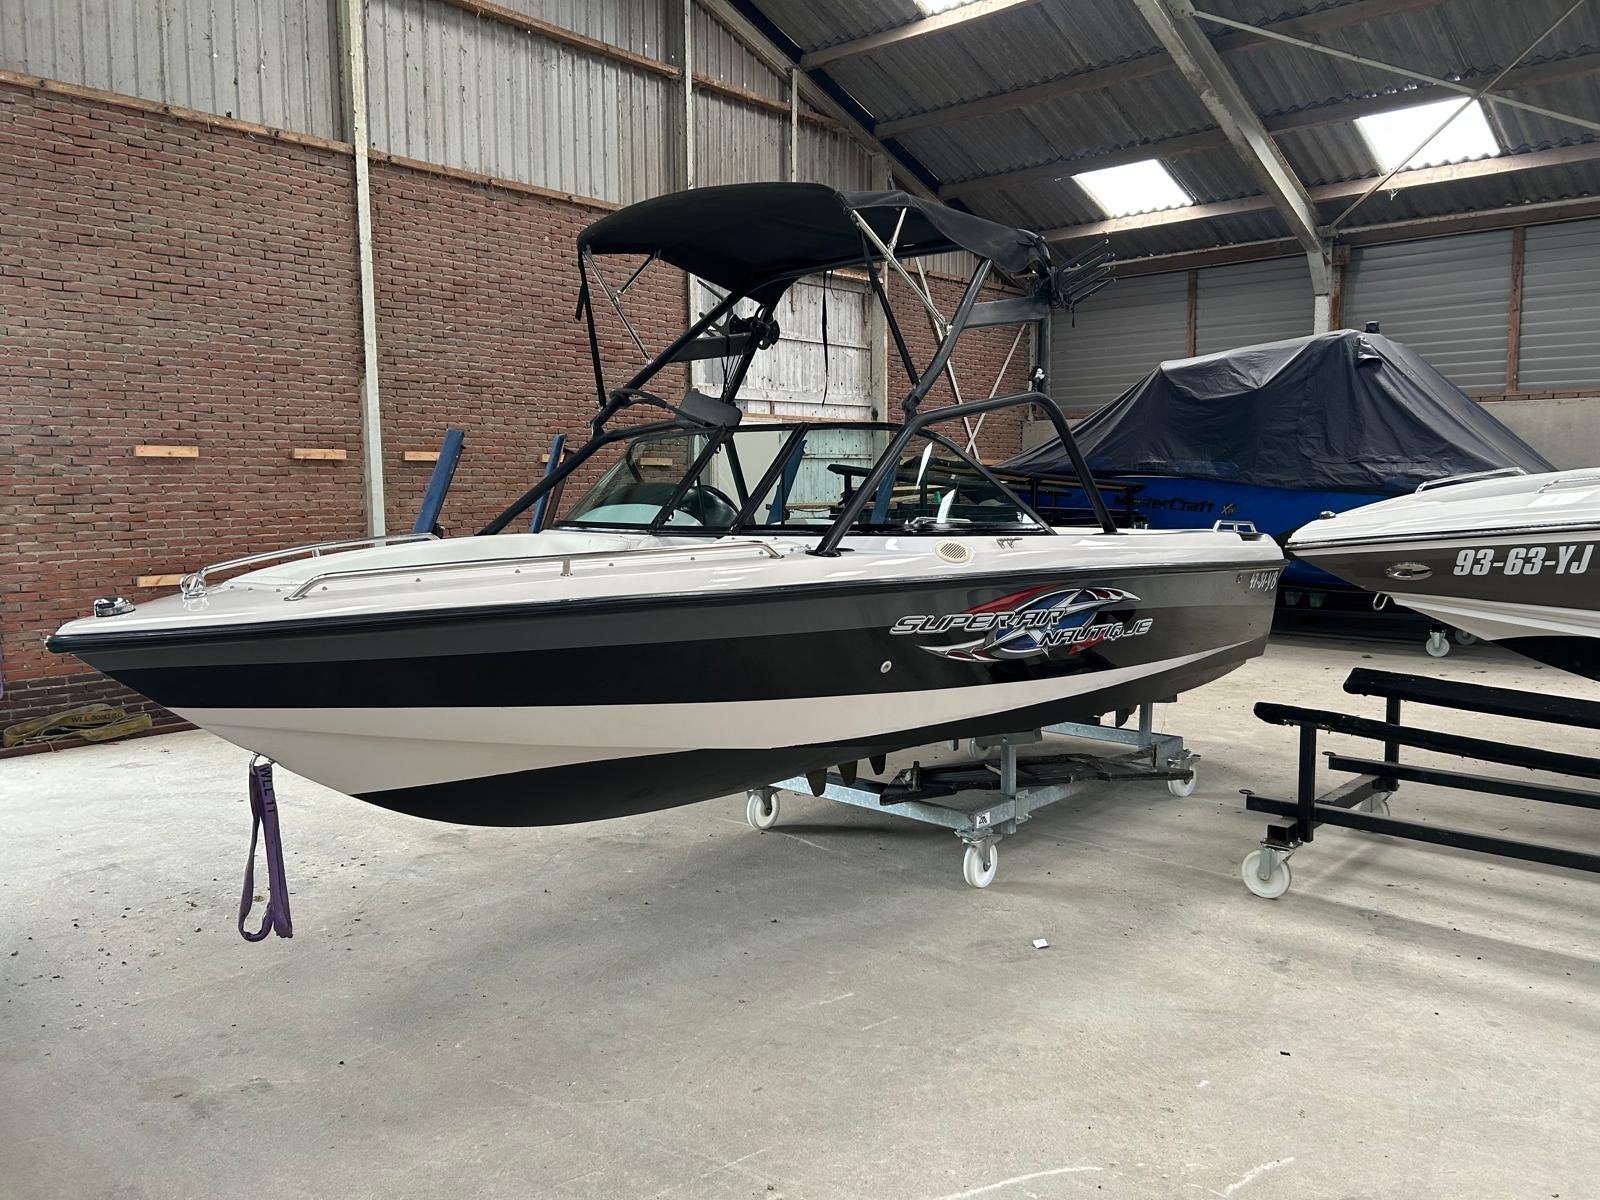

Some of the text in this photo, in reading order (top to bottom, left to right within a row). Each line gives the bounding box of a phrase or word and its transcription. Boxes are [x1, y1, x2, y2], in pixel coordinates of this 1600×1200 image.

[1452, 544, 1595, 576] 93-63-YJ
[889, 608, 1067, 636] SUPER AIR
[1037, 618, 1154, 647] NAUTIQUE
[259, 765, 273, 796] WLL
